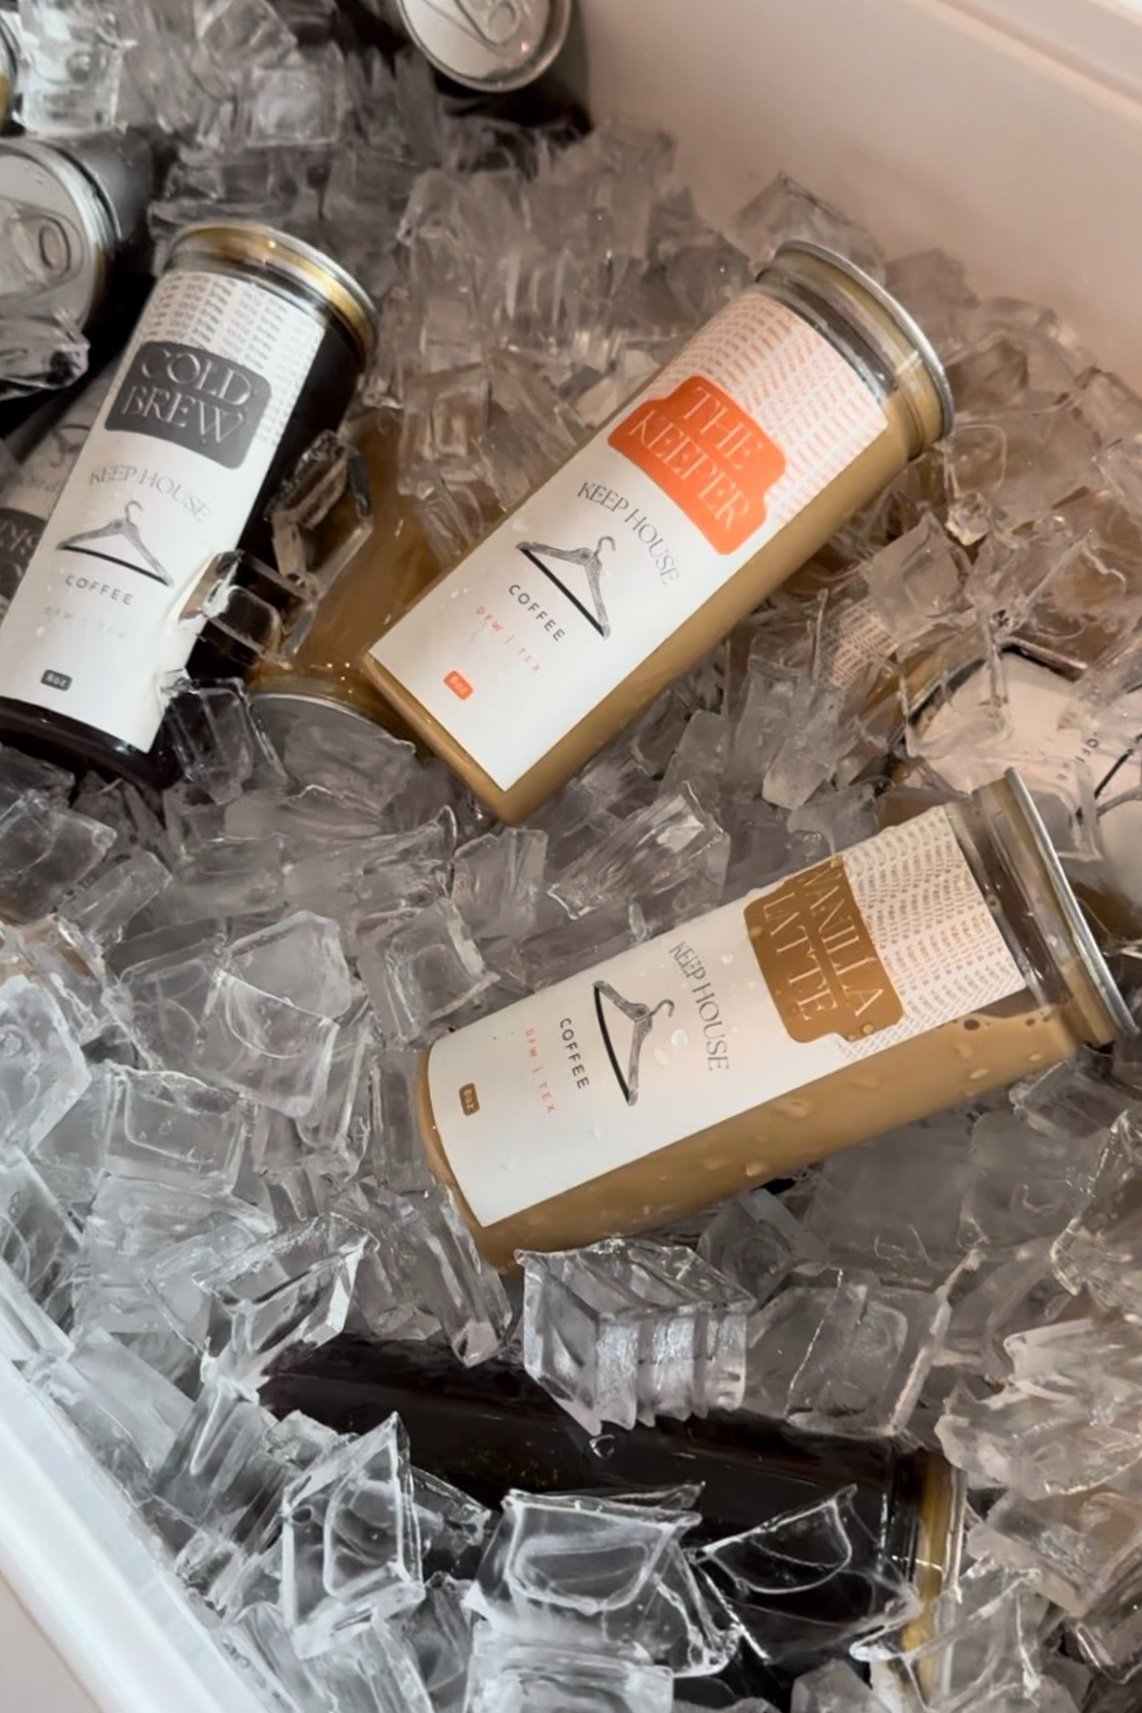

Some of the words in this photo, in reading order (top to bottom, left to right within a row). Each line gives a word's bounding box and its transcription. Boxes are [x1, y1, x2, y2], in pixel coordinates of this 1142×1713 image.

[121, 385, 243, 443] BREW
[142, 348, 252, 406] COLD
[682, 385, 764, 471] THE
[88, 464, 138, 486] KEEP
[139, 469, 210, 523] HOUSE
[628, 410, 750, 531] KEEPER
[577, 481, 630, 512] KEEP
[623, 508, 680, 586] HOUSE
[65, 574, 134, 606] COFFEE
[508, 584, 565, 641] COFFEE
[763, 891, 838, 1020] LATTE
[796, 862, 884, 1017] VANILLA
[669, 940, 706, 980] KEEP
[692, 982, 730, 1072] HOUSE
[559, 1017, 590, 1089] COFFEE
